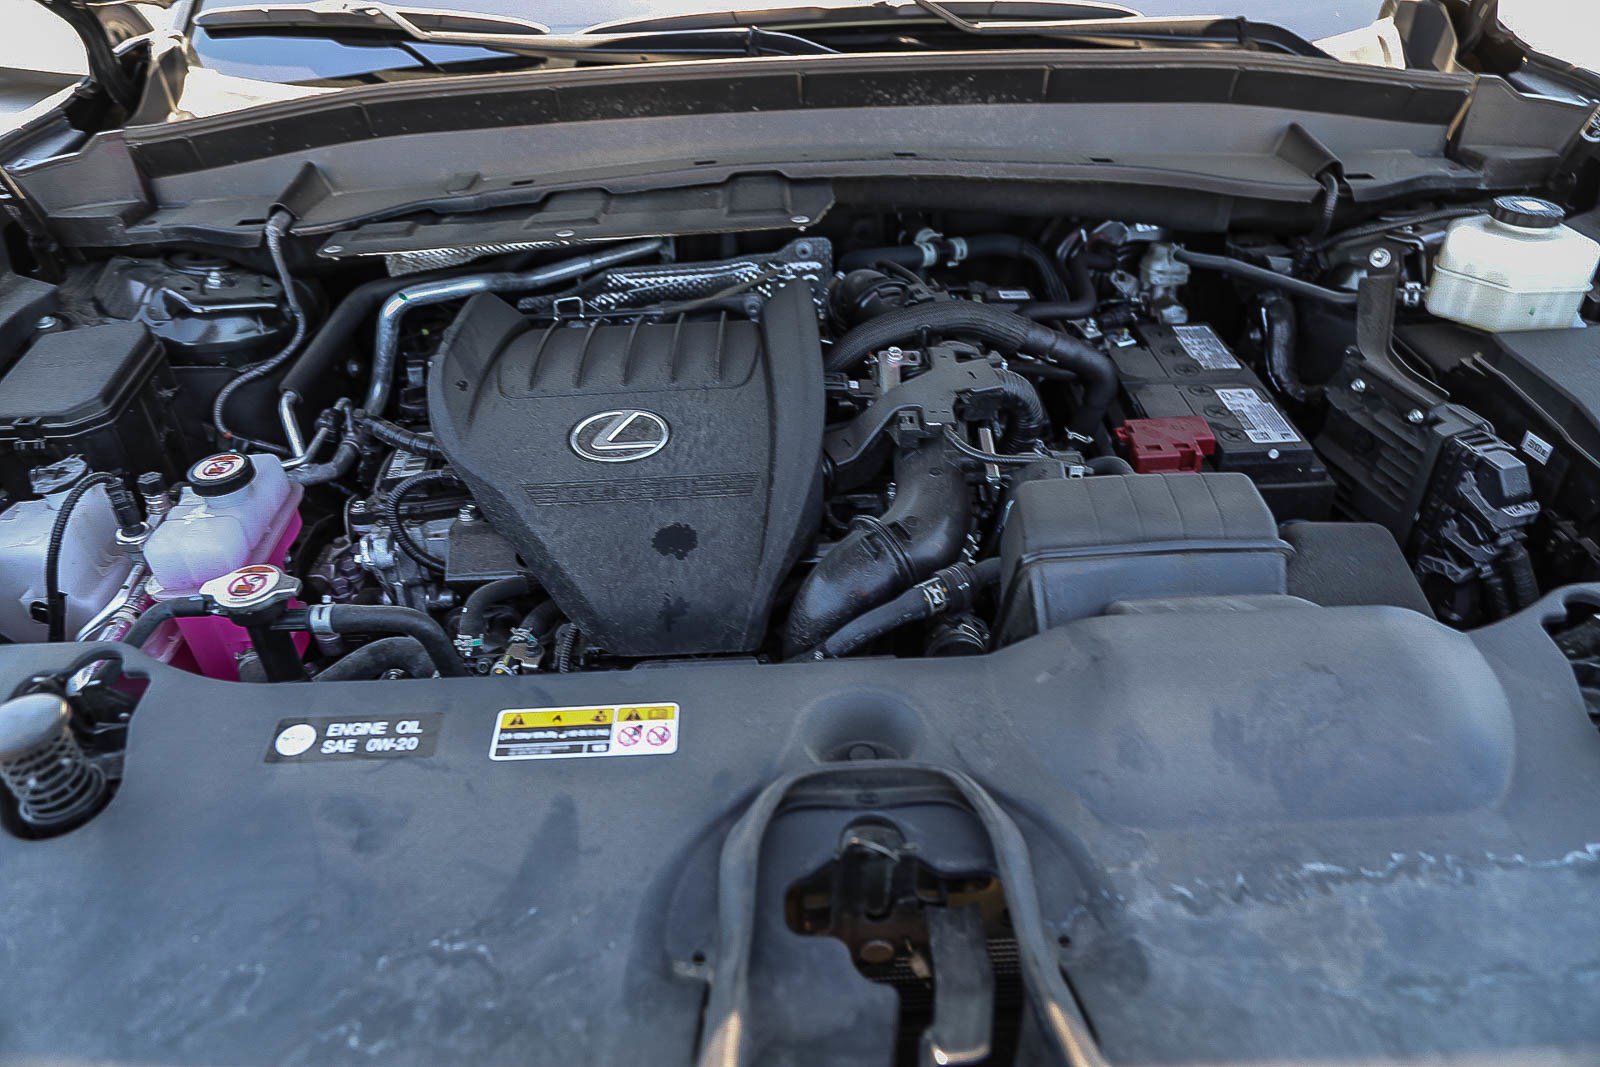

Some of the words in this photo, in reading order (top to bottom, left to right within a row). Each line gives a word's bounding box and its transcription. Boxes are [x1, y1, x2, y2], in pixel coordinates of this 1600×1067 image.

[326, 721, 388, 736] ENGINE
[395, 720, 423, 734] OIL
[320, 739, 357, 753] SAE
[365, 737, 419, 752] 0W-20
